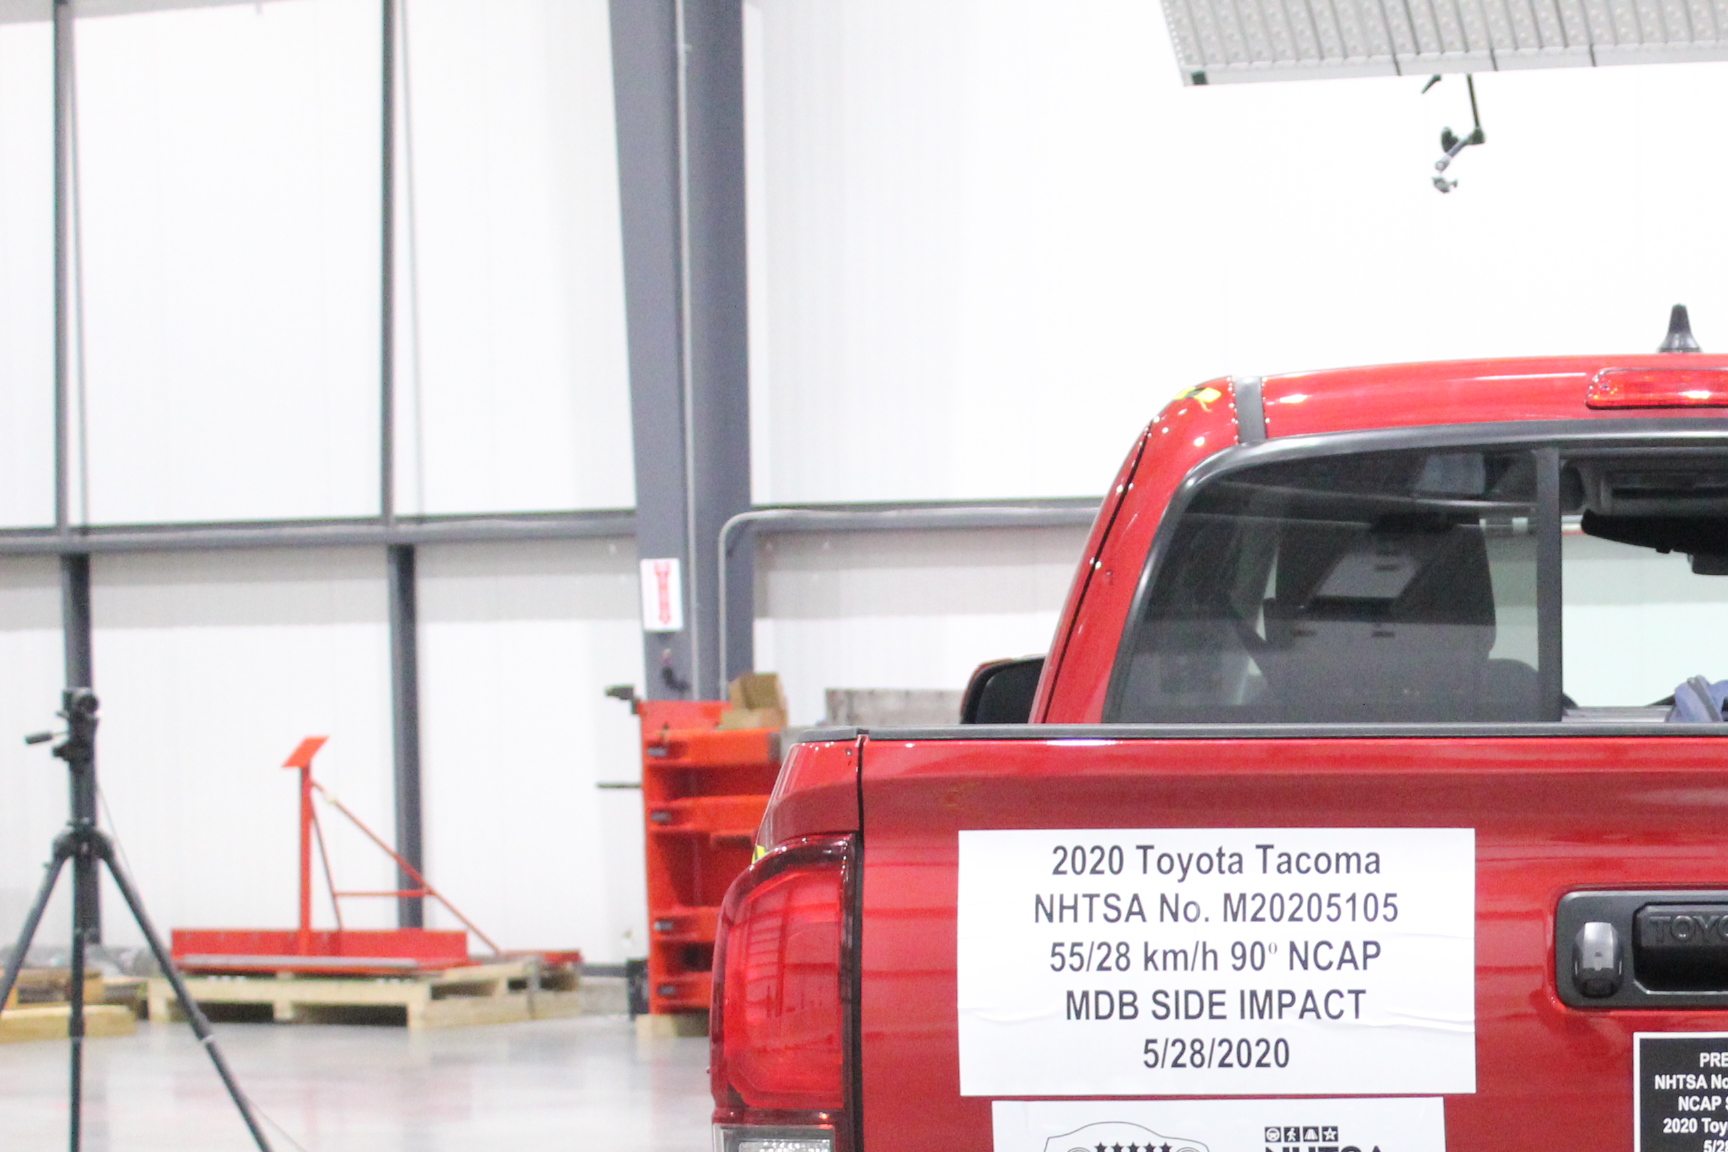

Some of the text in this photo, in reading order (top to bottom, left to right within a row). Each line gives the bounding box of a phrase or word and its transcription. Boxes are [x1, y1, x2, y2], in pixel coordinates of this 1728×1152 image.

[1052, 844, 1381, 882] 2020 Toyota Tacoma
[1034, 892, 1398, 924] NHTSA No. M20205105
[1049, 942, 1131, 972] 55/28
[1143, 942, 1218, 972] km/h
[1289, 941, 1381, 971] NCAP
[1066, 989, 1367, 1021] MDB SIDE IMPACT
[1143, 1037, 1290, 1068] 5/28/2020
[1655, 1075, 1707, 1090] NHTSA
[1678, 1096, 1722, 1112] NCAP
[1663, 1118, 1697, 1133] 2020
